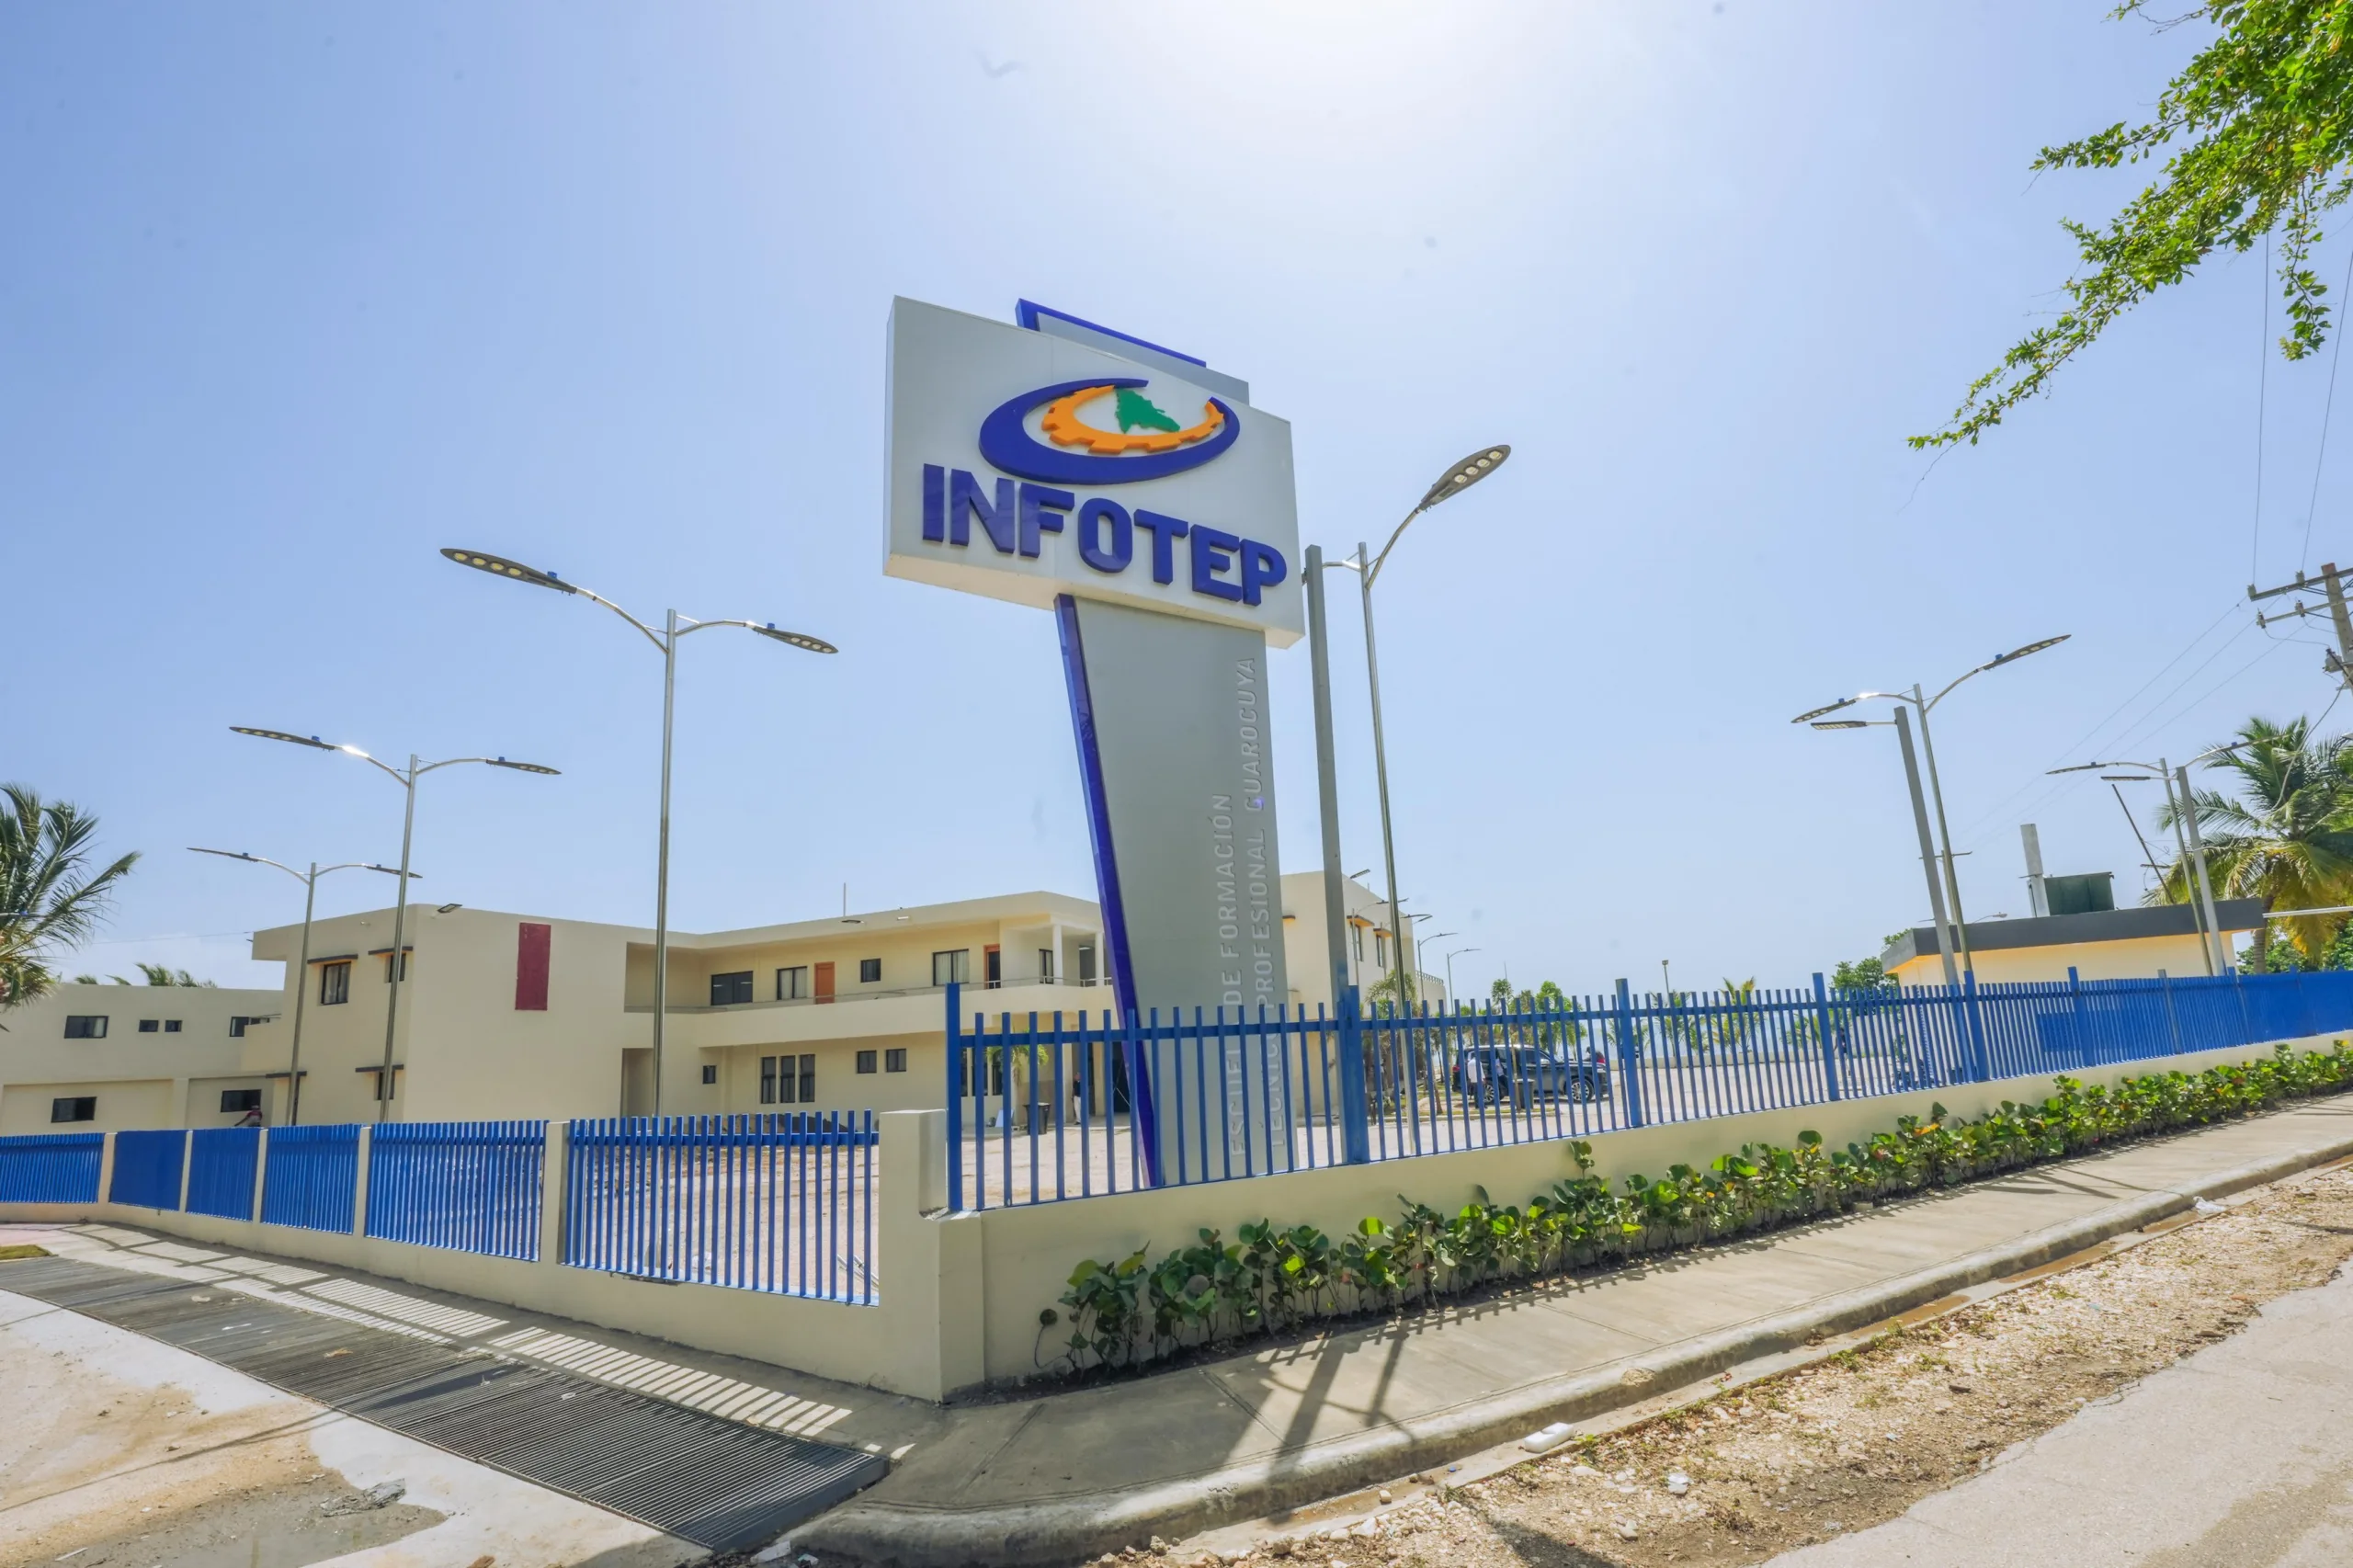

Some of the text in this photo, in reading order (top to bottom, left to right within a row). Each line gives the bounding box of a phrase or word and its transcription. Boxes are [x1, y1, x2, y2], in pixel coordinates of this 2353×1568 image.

[923, 463, 1287, 607] INFOTEP
[1208, 793, 1246, 1155] ESCUEL DE FORMACIÓN
[1236, 657, 1285, 1147] TÉCNIC PROFESIONAL GUAROCUYA
